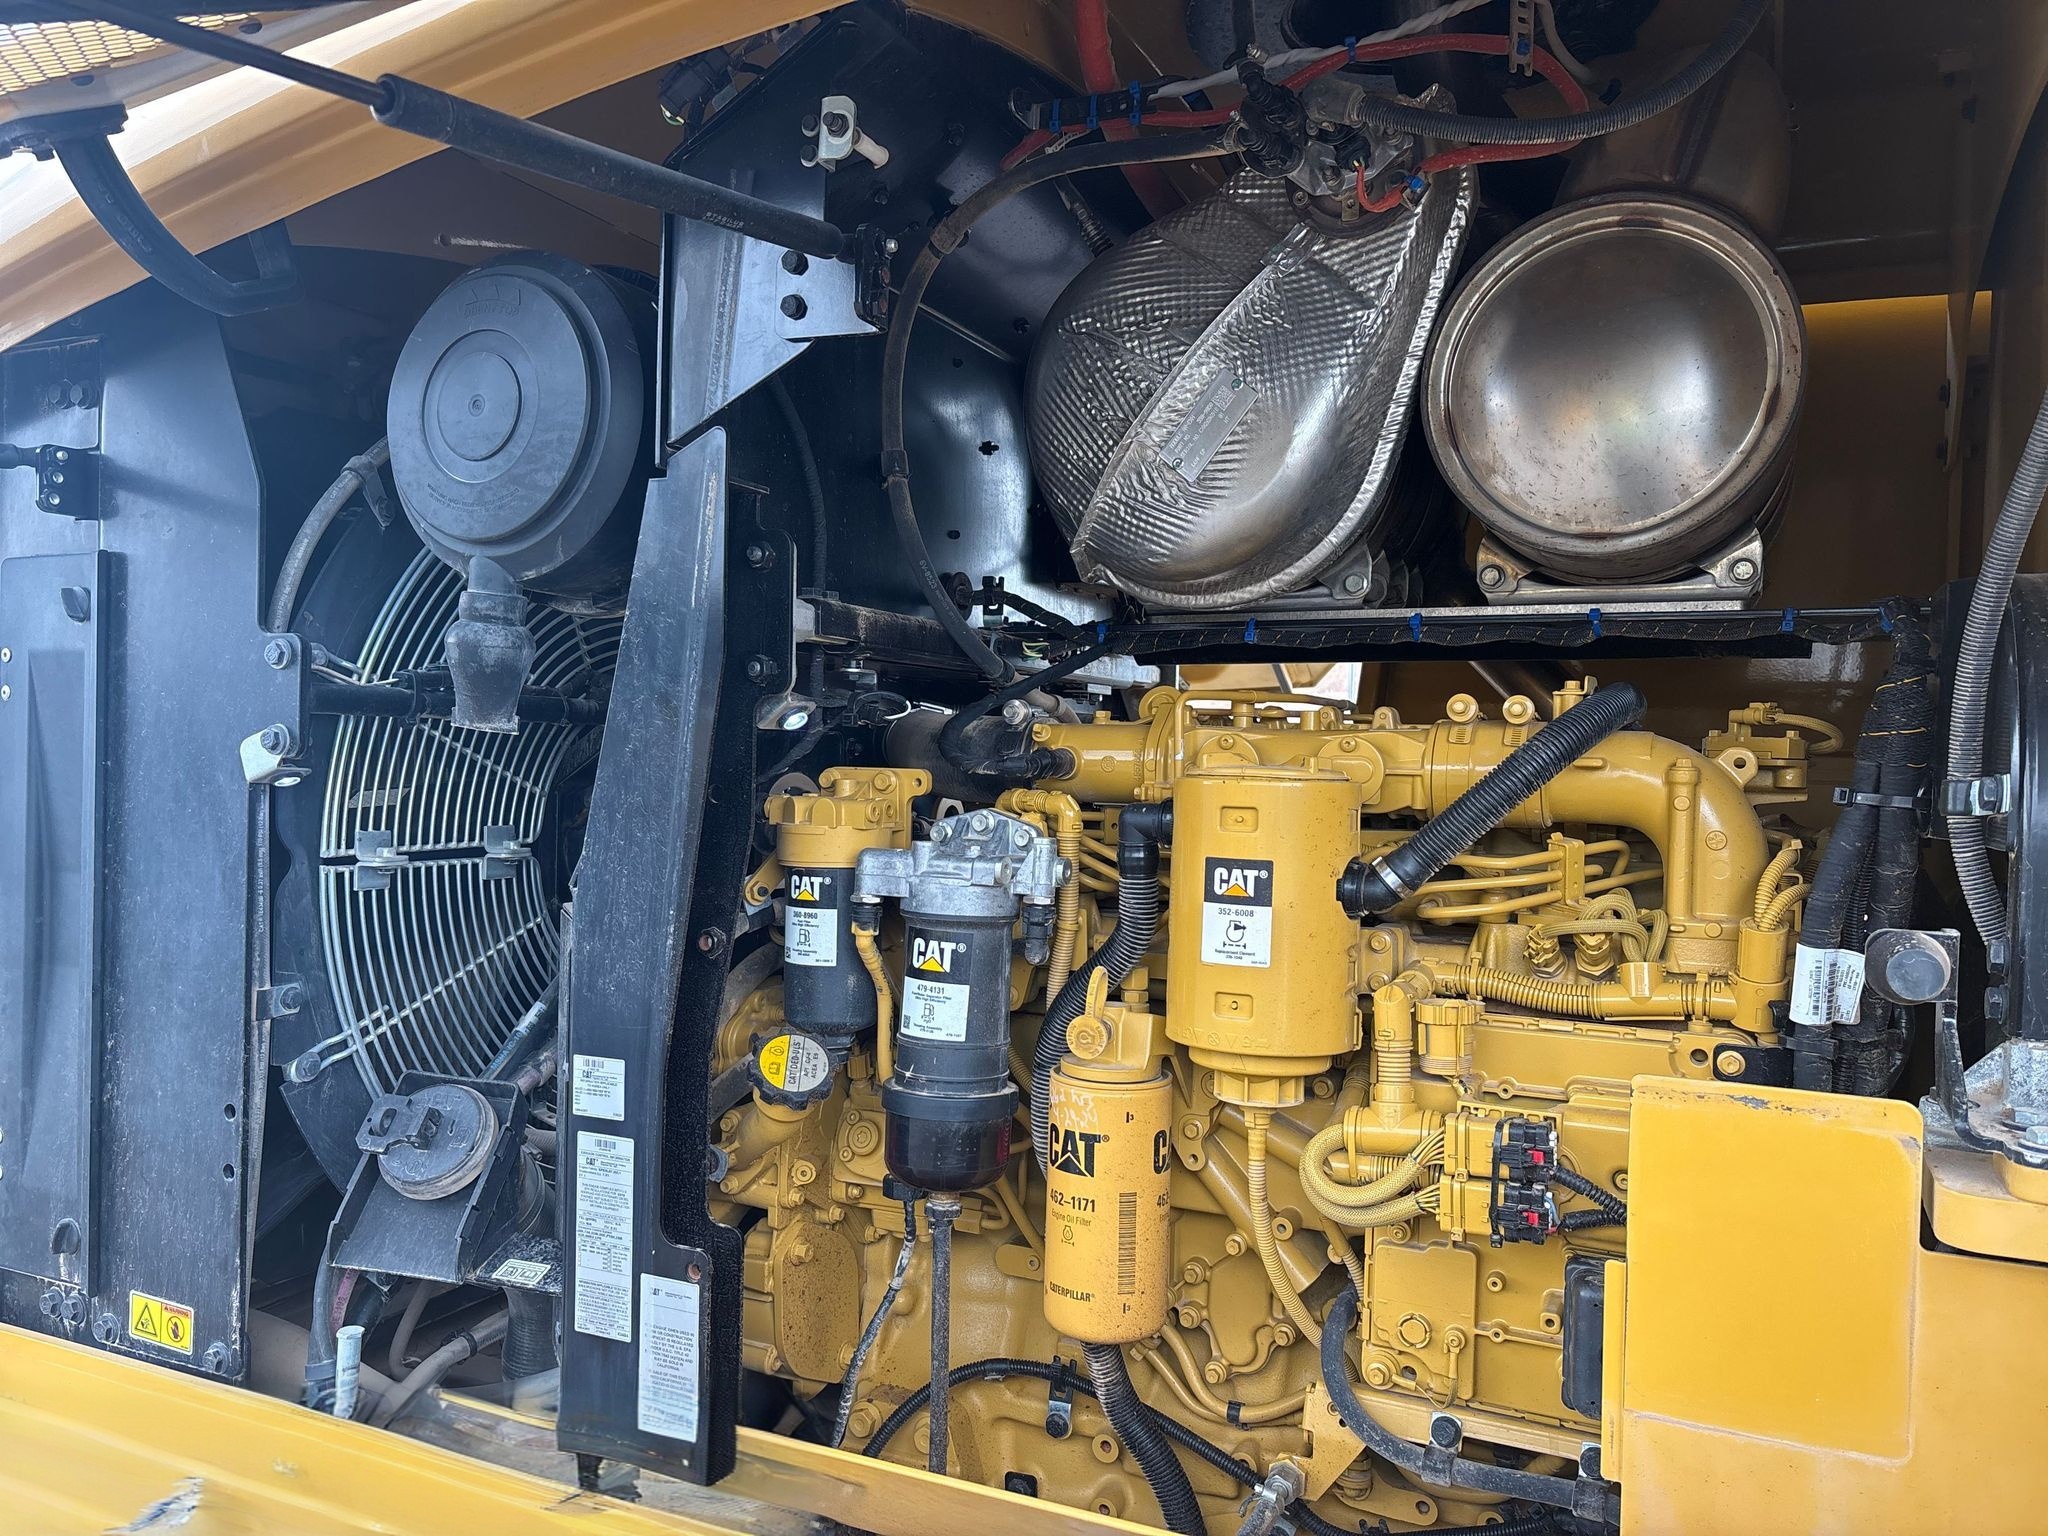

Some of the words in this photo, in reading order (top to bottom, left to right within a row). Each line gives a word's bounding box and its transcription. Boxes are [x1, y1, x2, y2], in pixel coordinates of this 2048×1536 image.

[791, 874, 823, 901] CAT
[1214, 867, 1258, 898] CAT
[794, 911, 818, 920] 360-8960
[1218, 908, 1254, 917] 352-6008
[912, 938, 956, 974] CAT
[917, 984, 945, 994] 479-4131
[582, 1069, 592, 1078] CAT
[788, 1070, 796, 1085] CAT
[810, 1064, 818, 1078] ACEA
[1050, 1122, 1102, 1178] CAT
[586, 1157, 595, 1166] CAT
[1050, 1188, 1096, 1212] 462-1171
[1052, 1208, 1066, 1222] Engine
[1066, 1214, 1074, 1224] Oil
[1076, 1216, 1092, 1227] Filter
[1050, 1281, 1091, 1302] CATERPILLAR
